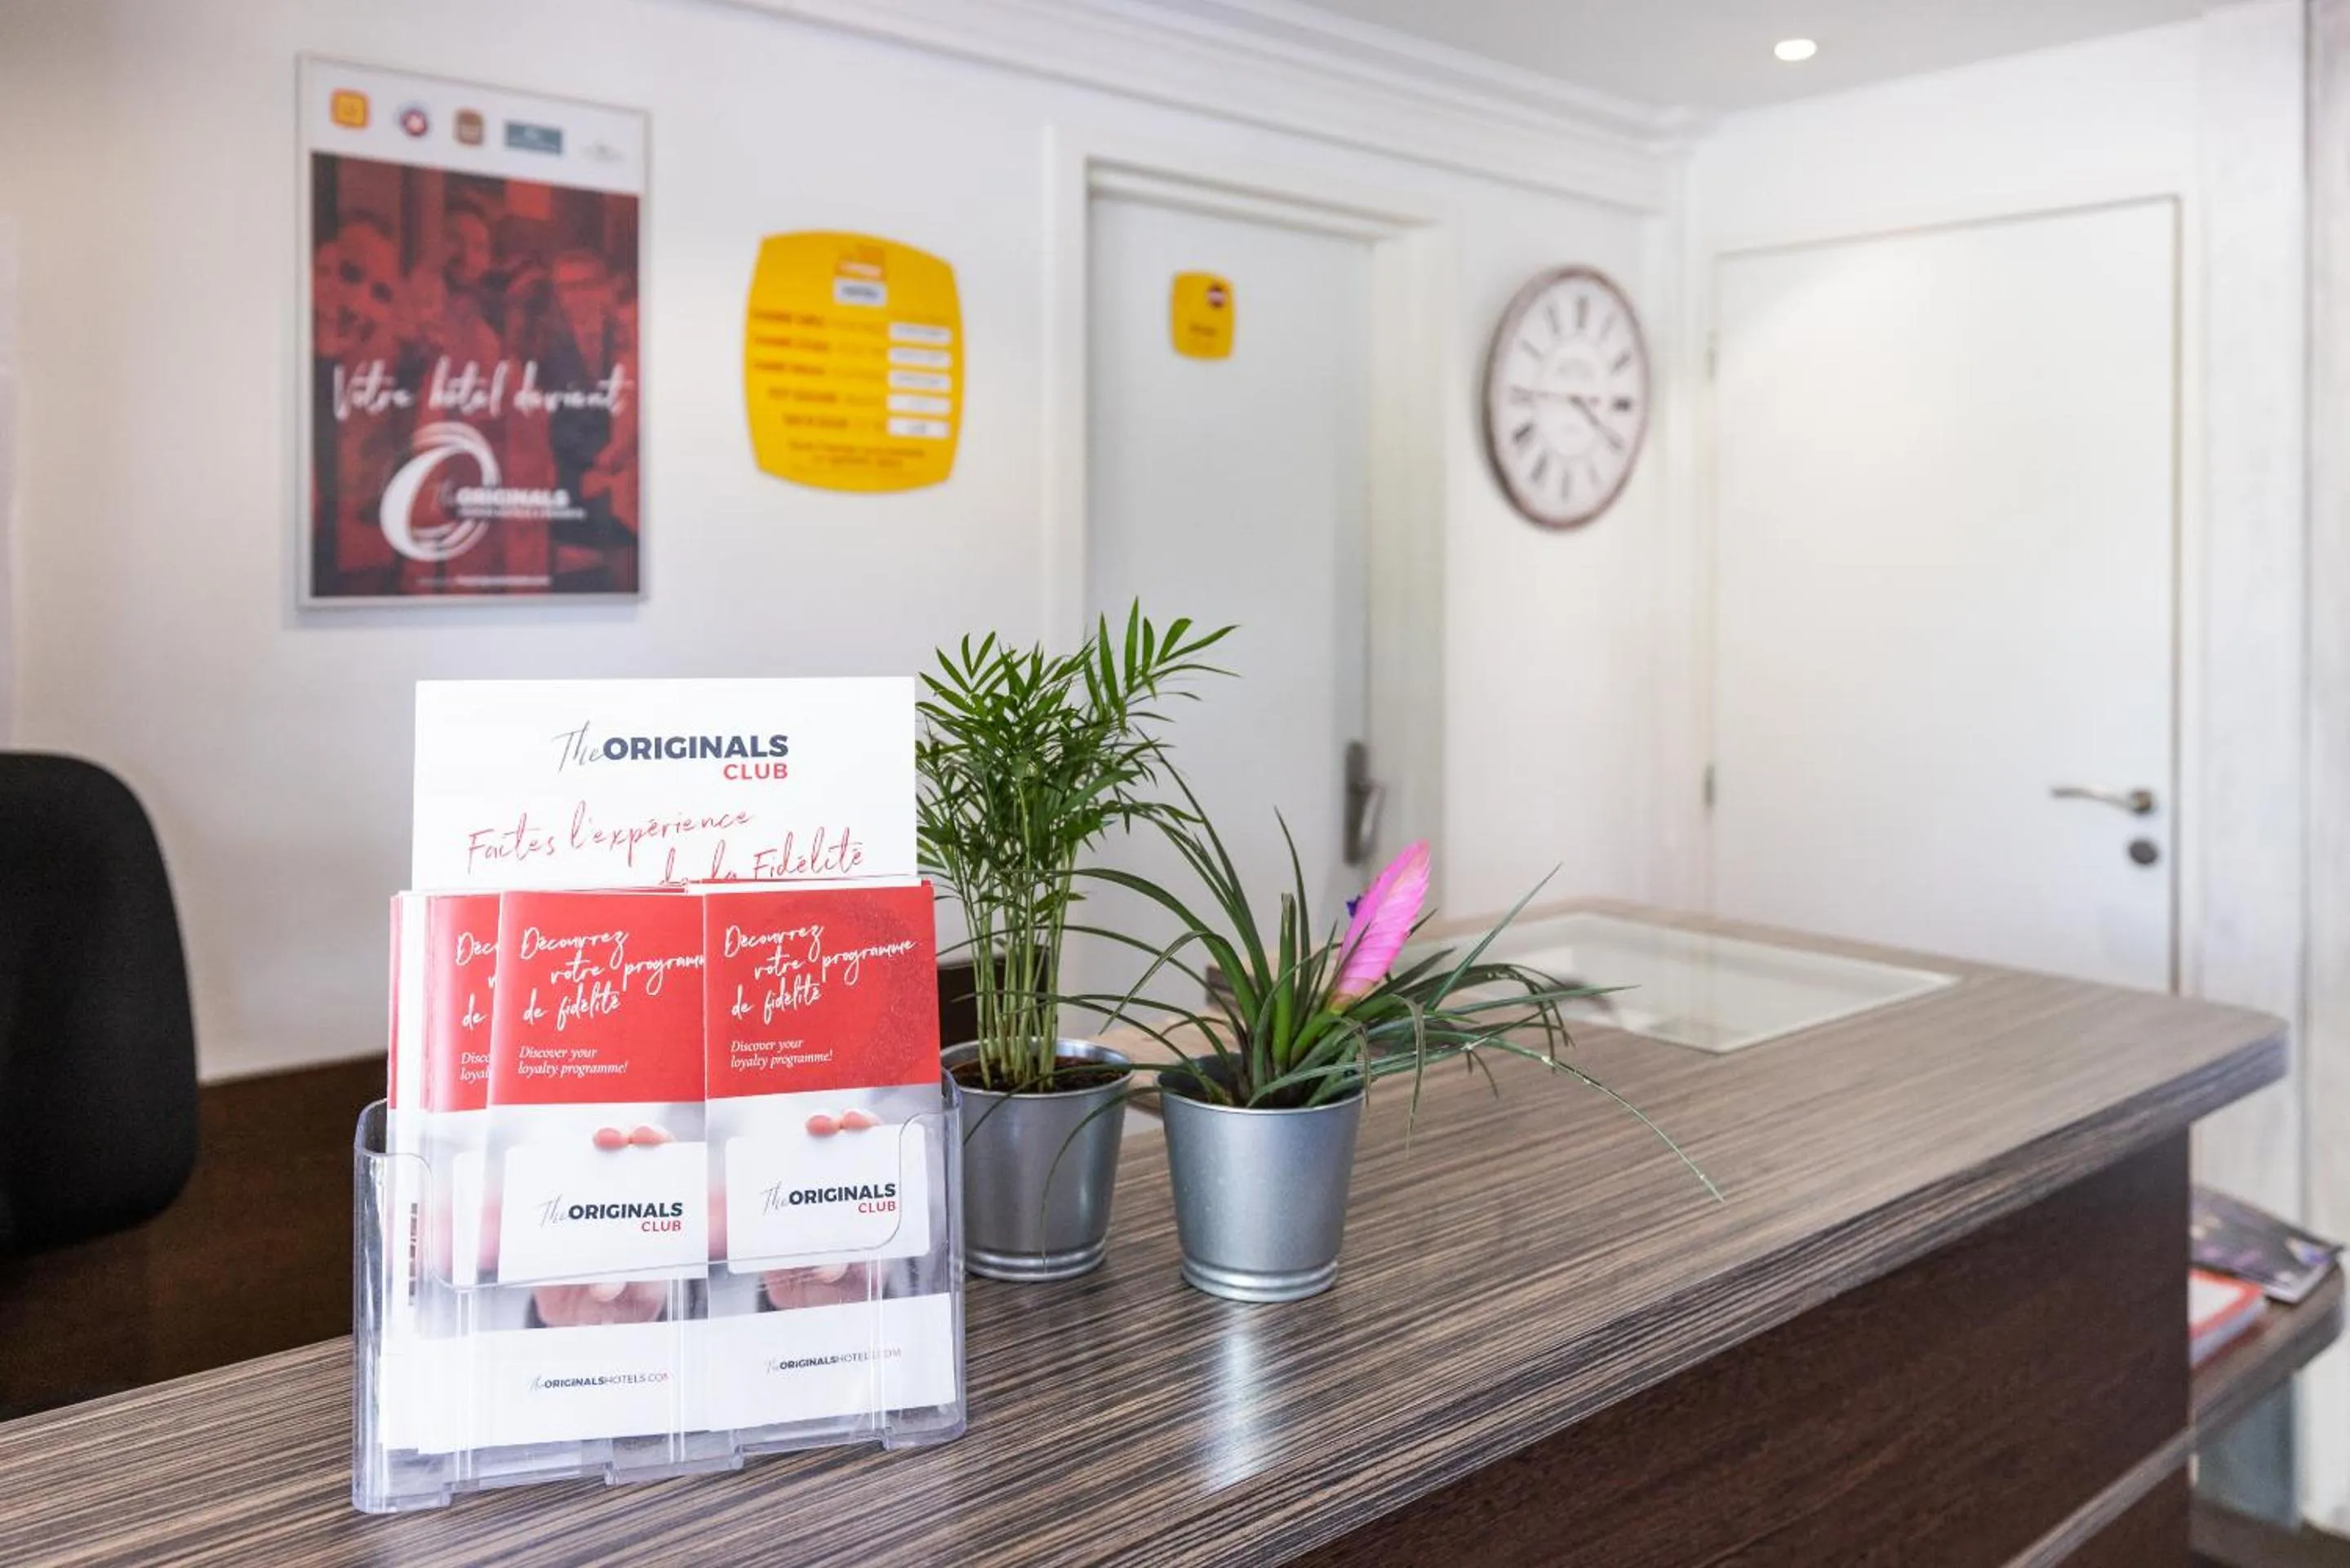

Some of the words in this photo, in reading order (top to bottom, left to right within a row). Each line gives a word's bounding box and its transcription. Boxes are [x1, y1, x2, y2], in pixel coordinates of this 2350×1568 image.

[723, 762, 789, 781] CLUB
[468, 813, 557, 875] Faites
[550, 949, 605, 984] votre
[754, 945, 805, 979] votre
[821, 939, 917, 986] programme
[462, 993, 486, 1030] de
[522, 988, 549, 1025] de
[731, 984, 754, 1020] de
[518, 1046, 568, 1059] Discover
[570, 1047, 597, 1061] your
[731, 1041, 775, 1052] Discover
[776, 1039, 804, 1055] your
[518, 1061, 559, 1077] loyalty
[730, 1054, 768, 1072] loyalty
[859, 1201, 896, 1213] CLUB
[641, 1219, 682, 1232] CLUB
